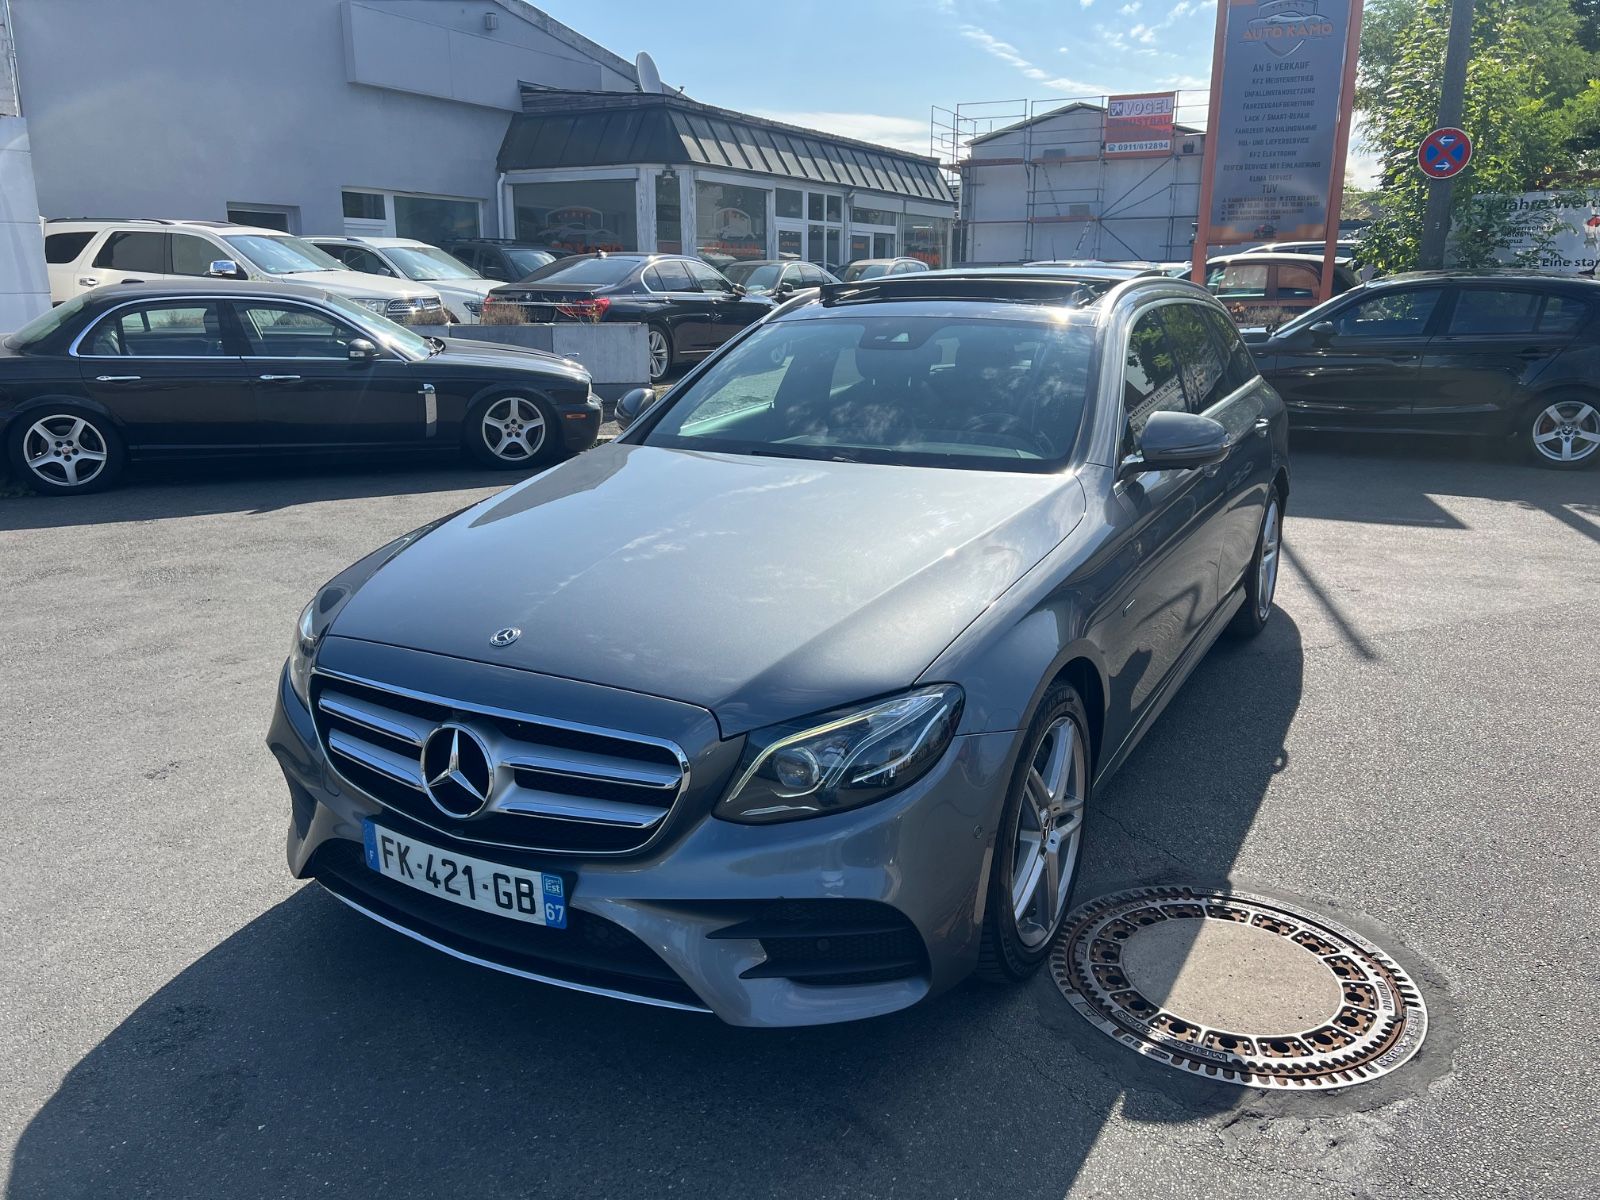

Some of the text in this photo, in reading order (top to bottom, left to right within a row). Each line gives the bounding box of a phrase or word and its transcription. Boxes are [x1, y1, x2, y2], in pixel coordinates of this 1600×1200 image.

[1242, 22, 1334, 40] AUTO KAMO
[1252, 63, 1264, 72] AN
[1274, 61, 1311, 71] VERKAUF
[1123, 100, 1171, 115] VOGEL
[1542, 258, 1571, 267] Eine
[381, 835, 537, 915] FK-421-GB
[545, 883, 561, 894] Est
[546, 903, 564, 923] 67
